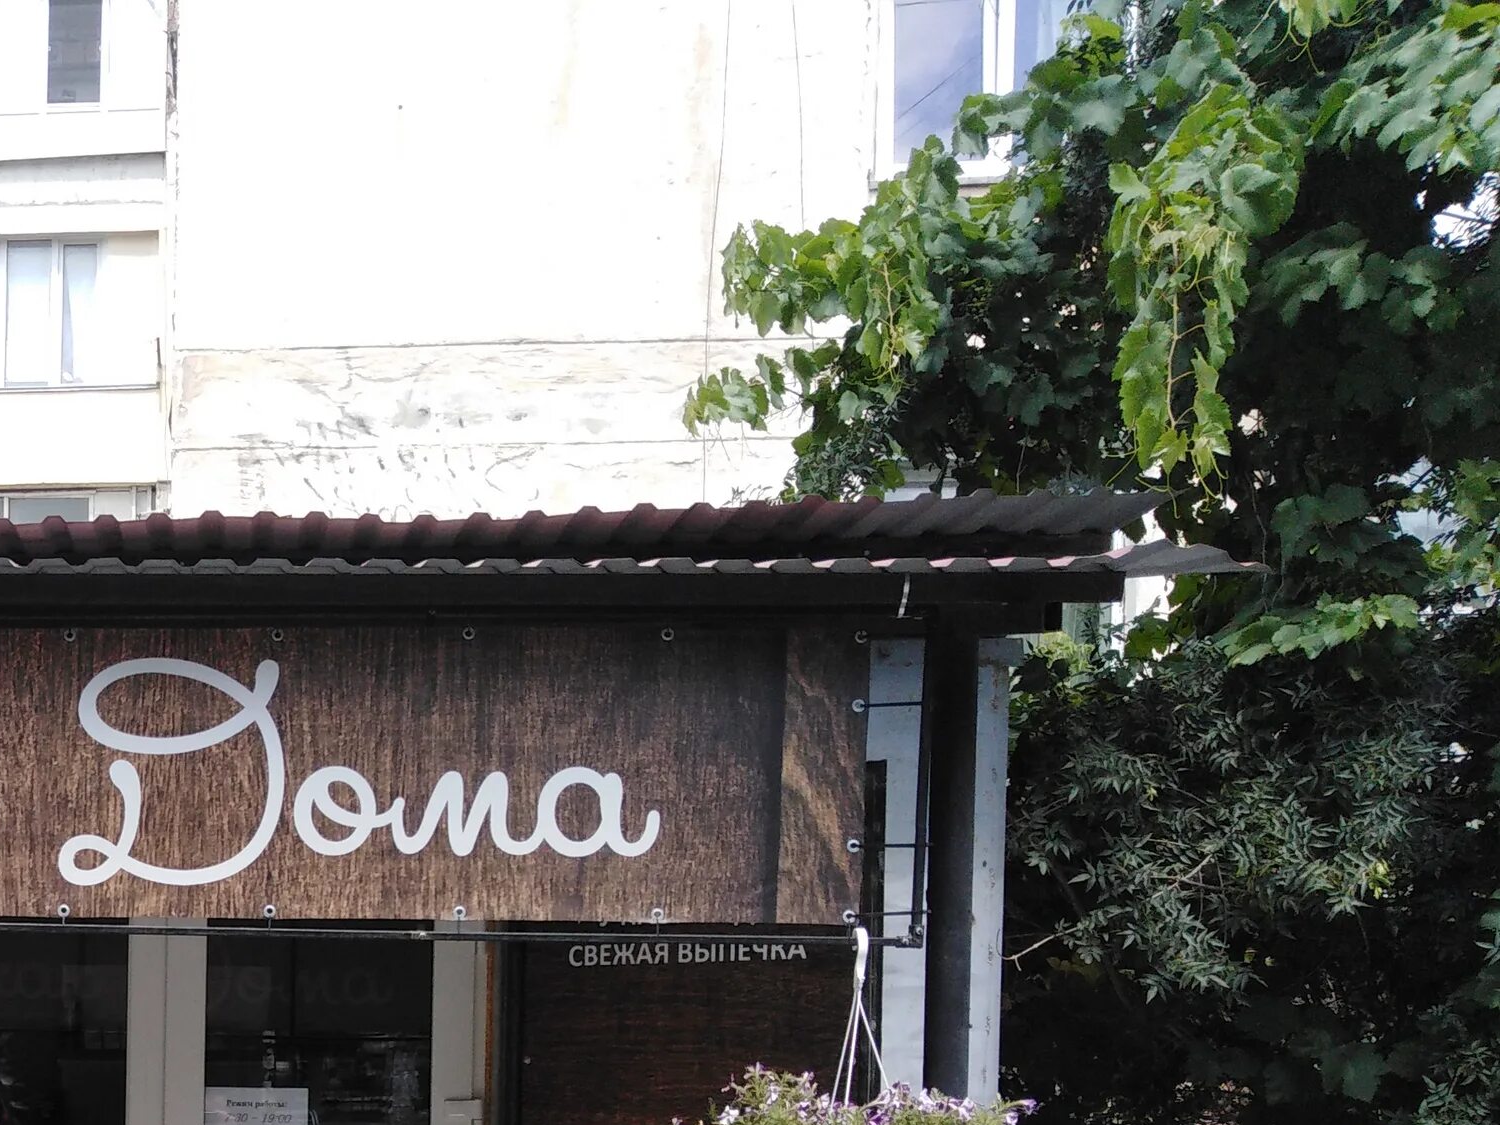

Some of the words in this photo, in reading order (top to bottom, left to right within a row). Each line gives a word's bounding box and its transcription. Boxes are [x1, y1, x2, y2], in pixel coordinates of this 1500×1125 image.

[58, 657, 660, 887] Дома
[568, 943, 669, 968] СВЕЖАЯ
[678, 943, 807, 964] ВЫПЕЧКА
